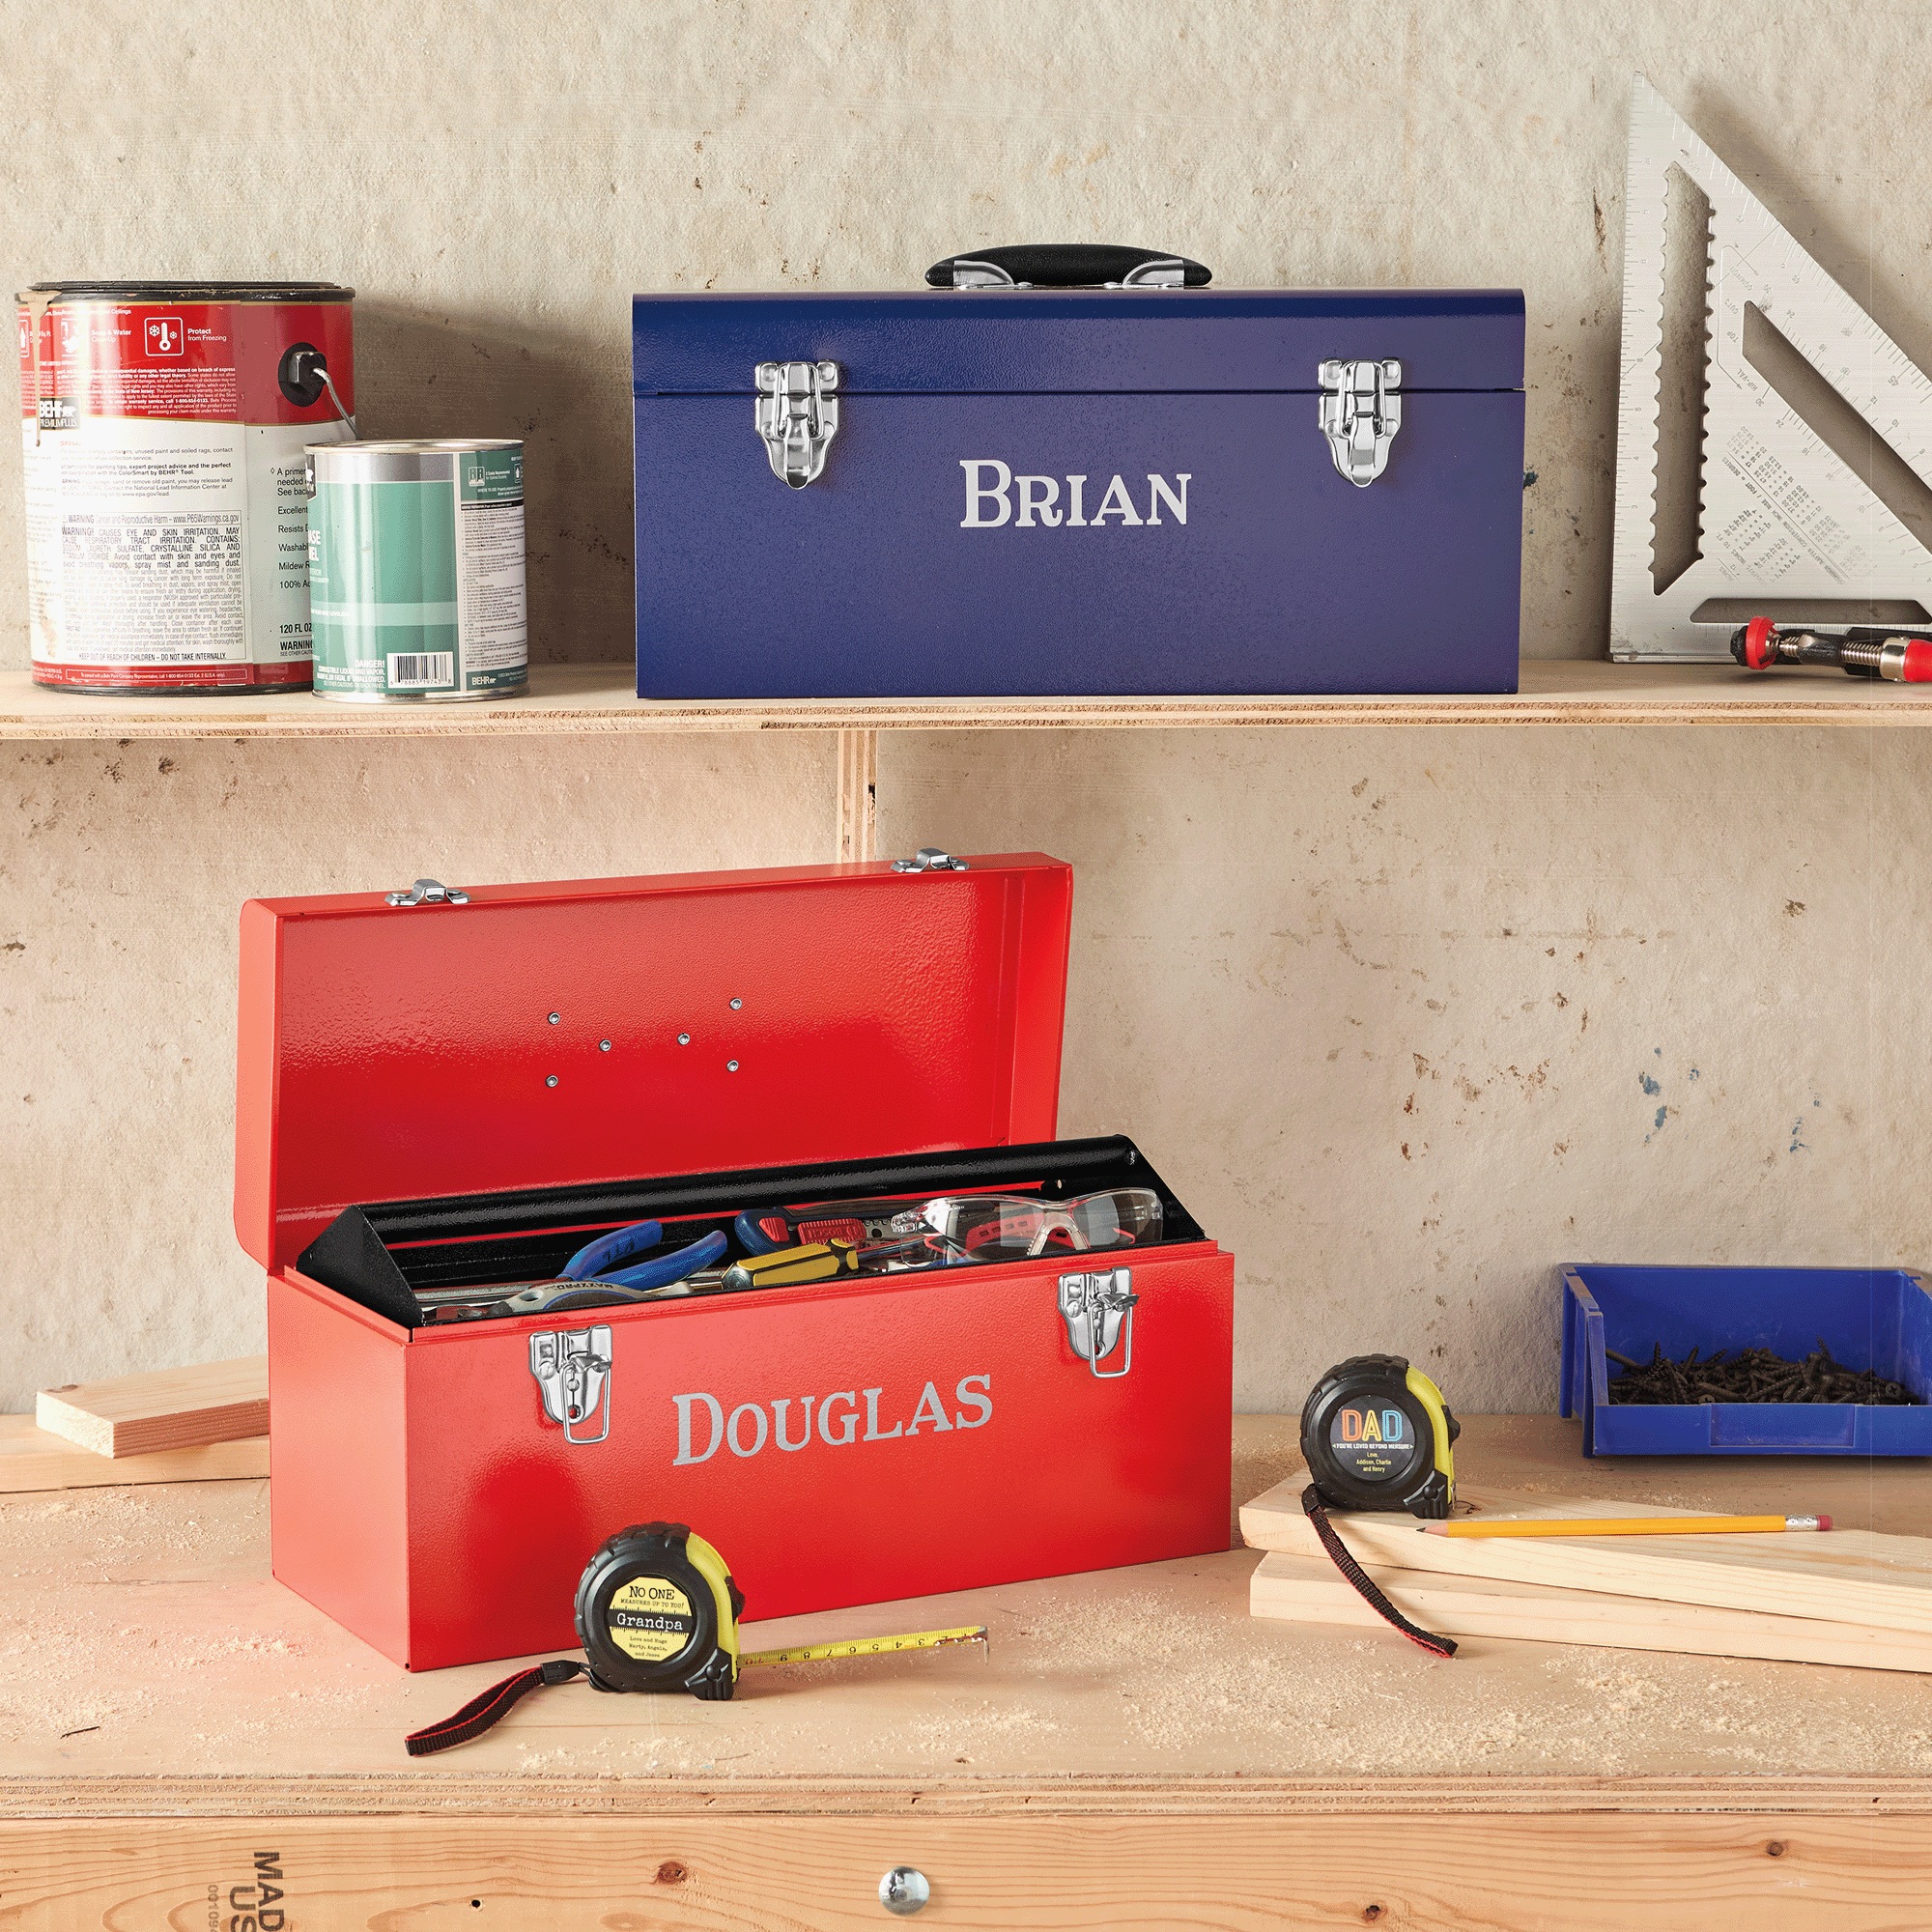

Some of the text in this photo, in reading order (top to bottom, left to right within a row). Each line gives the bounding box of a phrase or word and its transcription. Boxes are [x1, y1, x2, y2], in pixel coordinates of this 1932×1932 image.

[1726, 330, 1739, 343] TOP
[1737, 368, 1759, 392] HIP-VAL
[1888, 375, 1899, 387] 45
[1890, 418, 1900, 428] 10
[284, 467, 306, 477] primer
[277, 477, 303, 486] needed
[277, 486, 307, 497] See bac
[959, 459, 1192, 528] BRIAN
[1745, 482, 1758, 495] FOOT
[277, 506, 308, 515] Excellent
[99, 528, 122, 537] CAUSES
[127, 528, 138, 537] EYE
[226, 526, 240, 535] MAY
[277, 525, 304, 533] Resists
[130, 536, 151, 545] TRACT
[206, 534, 241, 543] CONTAINS:
[151, 544, 193, 553] CRYSTALLINE
[199, 543, 221, 552] SILICA
[226, 542, 241, 551] AND
[278, 543, 309, 552] Washabl
[210, 552, 225, 560] eyes
[134, 561, 152, 570] spray
[194, 559, 220, 569] sanding
[225, 558, 241, 567] dust.
[279, 580, 301, 589] 100%
[279, 624, 294, 634] 120
[295, 623, 302, 633] FL
[280, 639, 313, 651] WARNIN
[181, 652, 194, 661] TAKE
[355, 659, 385, 668] DANGER!
[471, 675, 490, 686] BEHR
[671, 1374, 994, 1466] DOUGLAS
[1341, 1408, 1403, 1442] DAD
[629, 1585, 675, 1601] NO ONE
[616, 1612, 684, 1633] Grandpa
[871, 1643, 880, 1652] 5
[918, 1638, 925, 1647] 3
[803, 1650, 810, 1660] 8
[826, 1648, 833, 1657] 7
[848, 1646, 857, 1655] 6
[780, 1652, 788, 1662] 9
[253, 1851, 285, 1932] MAD
[207, 1884, 219, 1932] 00109
[229, 1886, 258, 1932] US
